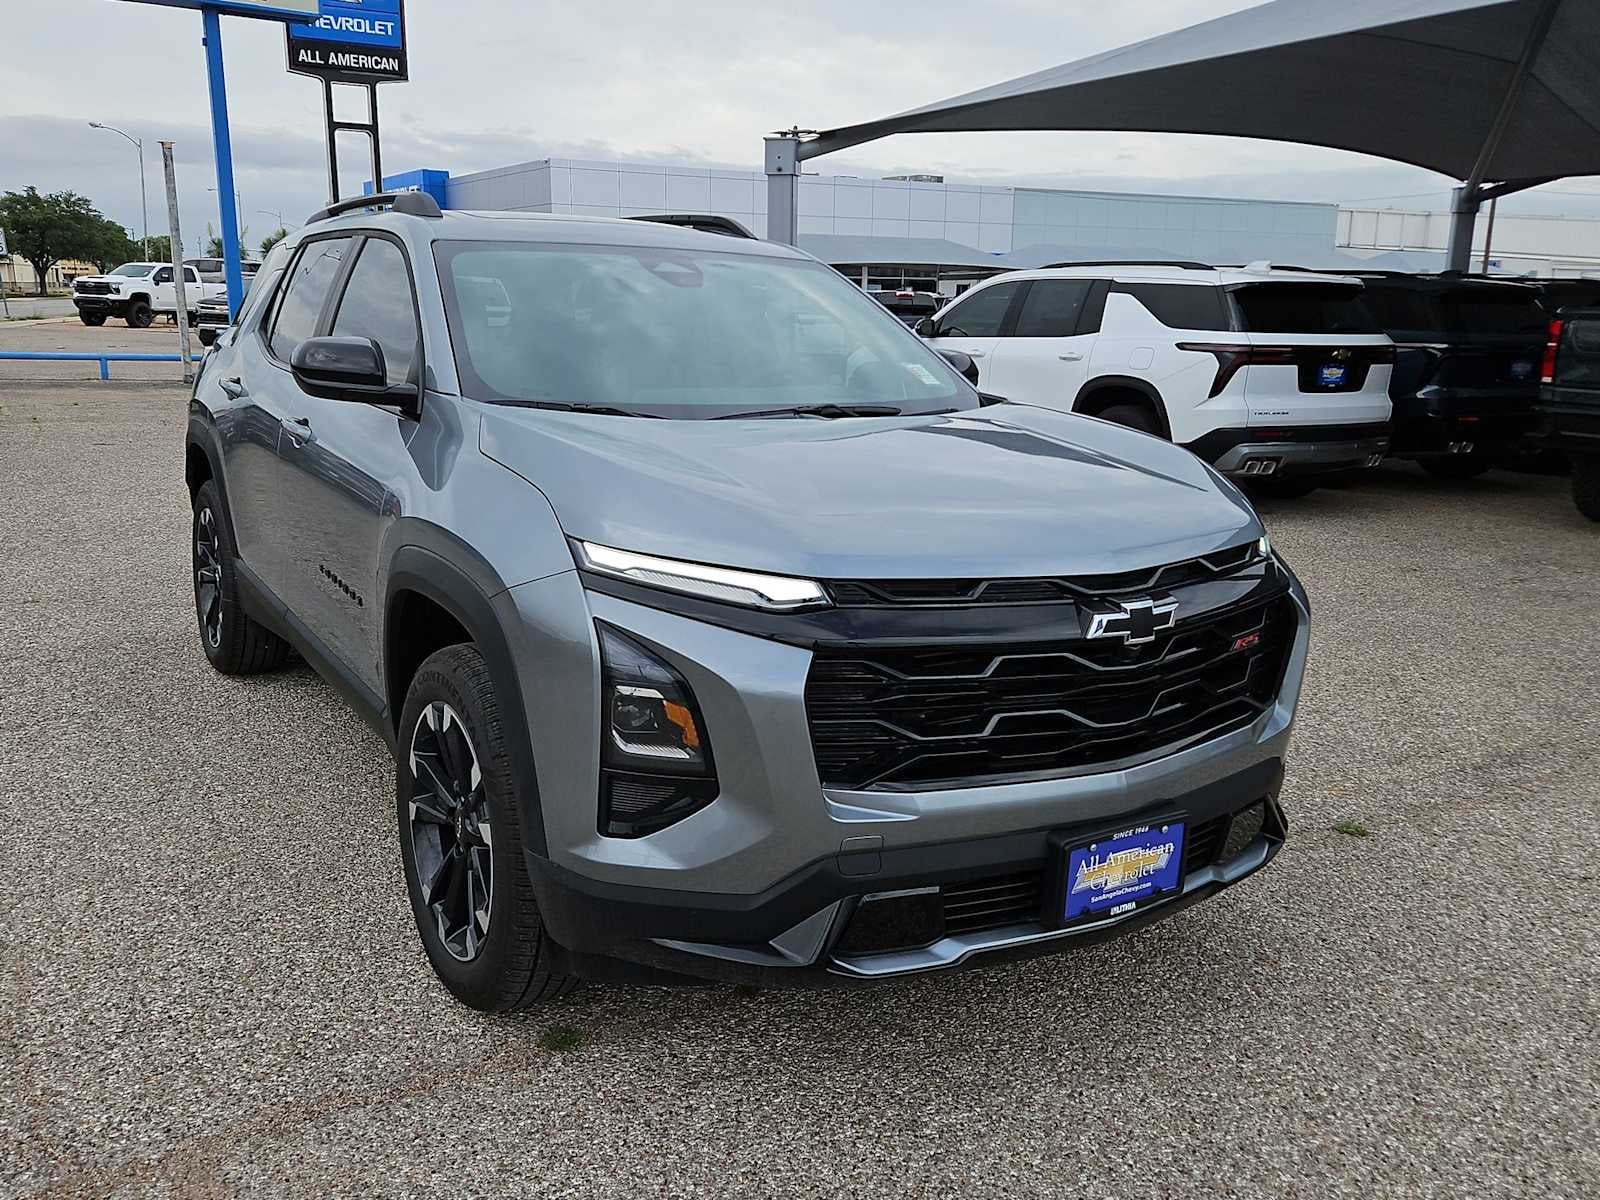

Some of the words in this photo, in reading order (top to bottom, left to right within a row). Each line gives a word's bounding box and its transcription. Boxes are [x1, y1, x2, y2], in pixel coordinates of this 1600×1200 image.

[308, 15, 395, 36] EVROLET
[298, 49, 324, 65] ALL
[328, 52, 399, 72] AMERICAN
[1112, 829, 1134, 841] SINCE
[1076, 854, 1099, 877] All
[1103, 842, 1175, 867] American
[1090, 861, 1155, 890] Chevrolet
[1090, 882, 1152, 903] SanAngeloChevy.com
